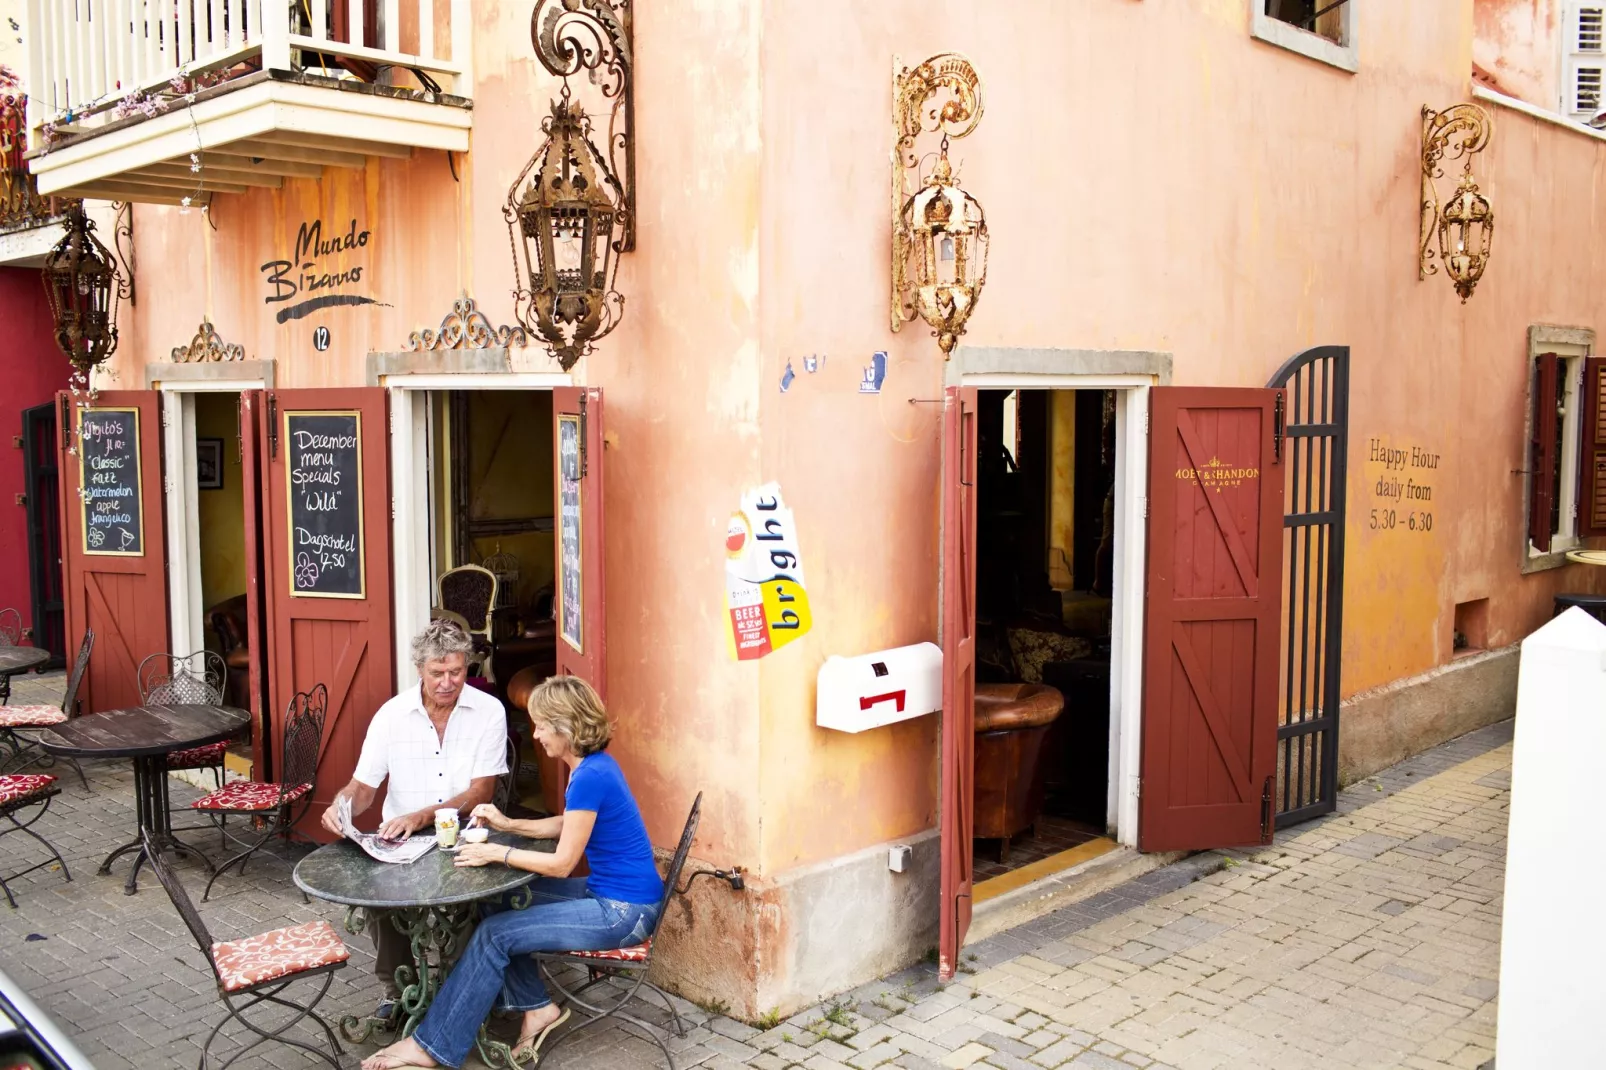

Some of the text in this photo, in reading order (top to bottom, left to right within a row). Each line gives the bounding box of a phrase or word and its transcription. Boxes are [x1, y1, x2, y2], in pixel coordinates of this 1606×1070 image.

[295, 218, 371, 267] Mundo
[316, 327, 328, 350] 12
[293, 430, 357, 449] December
[301, 452, 333, 467] menu
[1370, 438, 1440, 471] Happy Hour
[292, 467, 342, 490] Specials
[1203, 471, 1211, 480] &
[1375, 475, 1431, 503] daily from
[96, 499, 121, 514] apple
[1370, 508, 1396, 530] 5.30
[1408, 511, 1433, 532] 6.30
[735, 605, 762, 621] BEER
